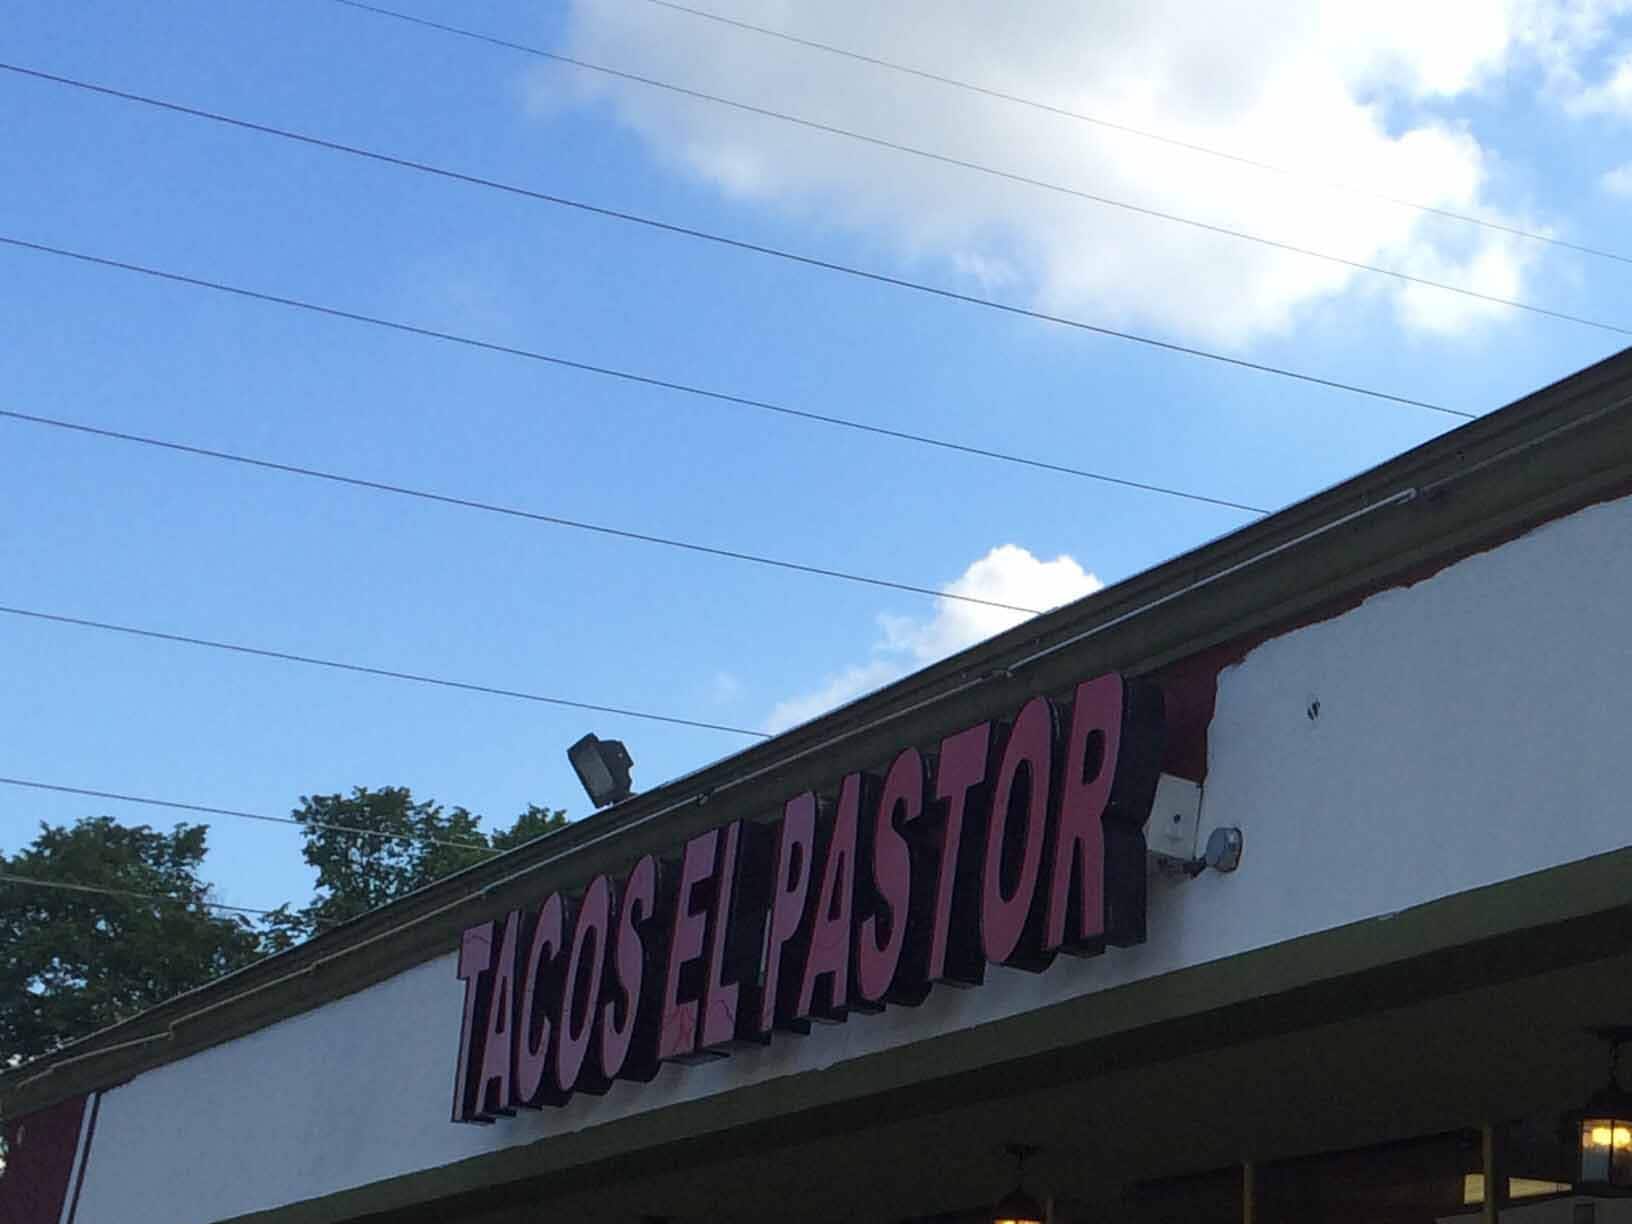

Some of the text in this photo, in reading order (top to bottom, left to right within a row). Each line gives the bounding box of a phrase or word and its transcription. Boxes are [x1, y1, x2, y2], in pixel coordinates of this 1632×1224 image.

[450, 670, 1127, 1123] TACOS EL PASTOR
